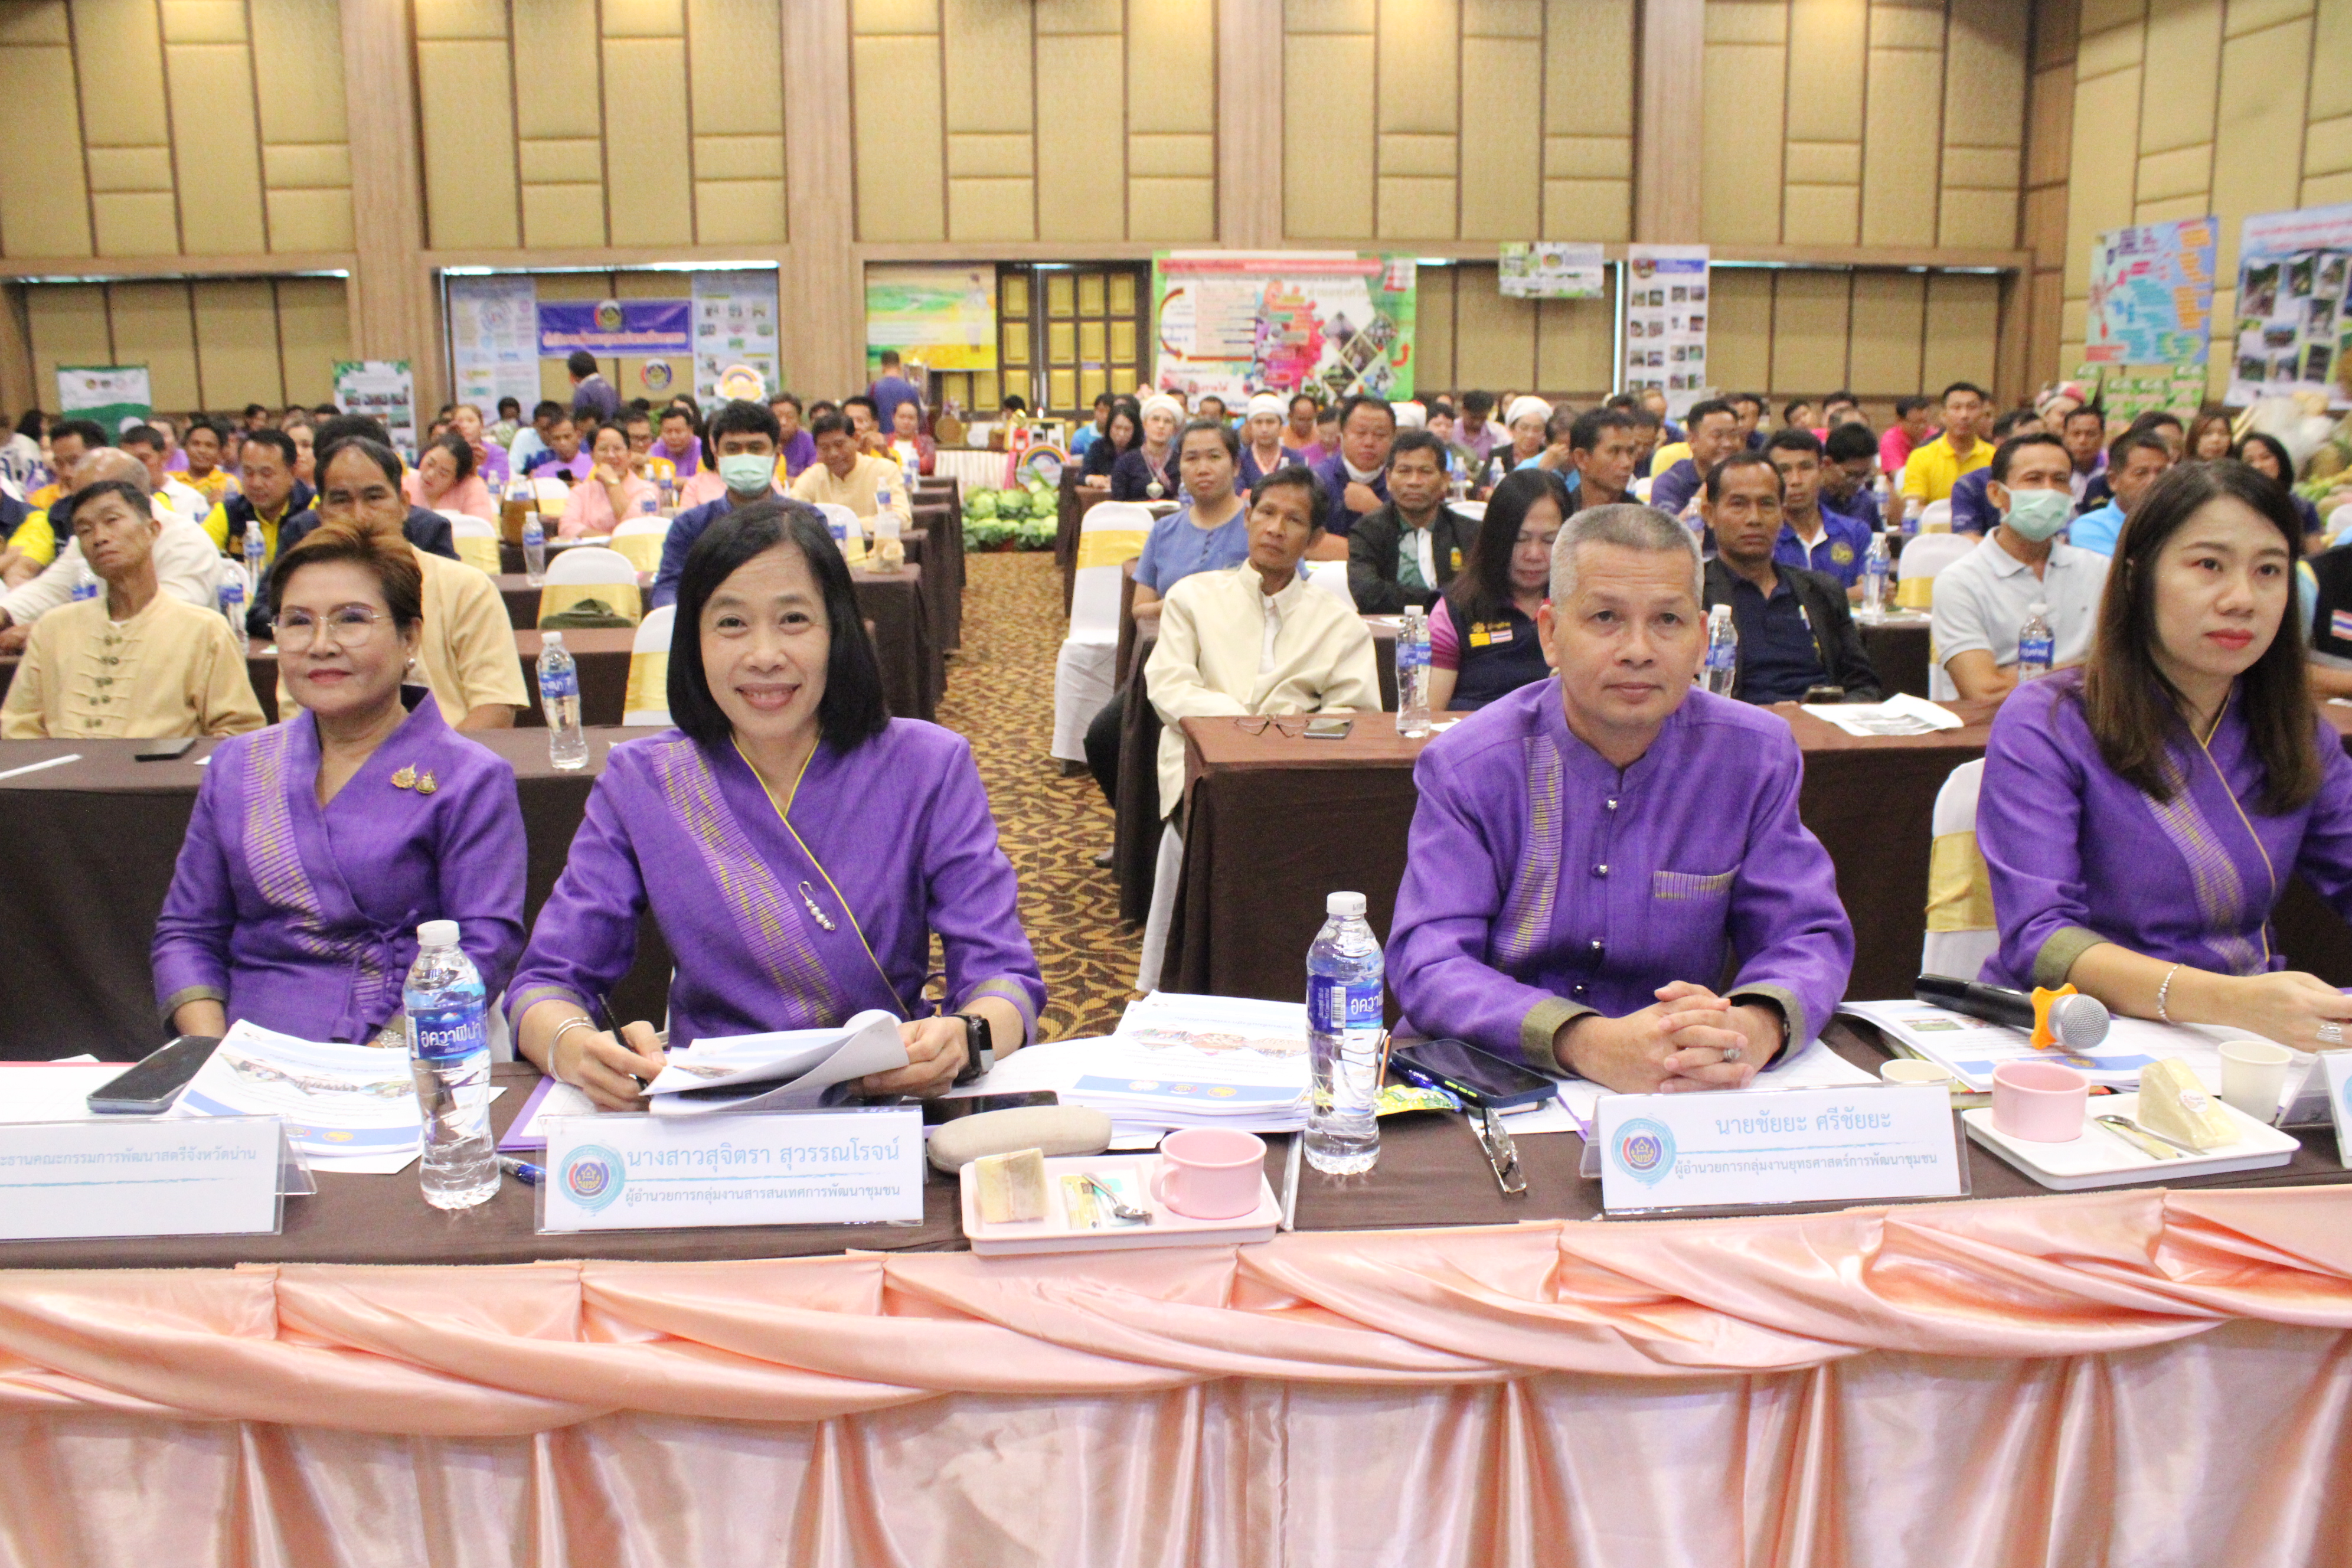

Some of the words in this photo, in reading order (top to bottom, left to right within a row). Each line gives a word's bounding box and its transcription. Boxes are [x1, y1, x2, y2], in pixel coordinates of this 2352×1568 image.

[1715, 1109, 1807, 1135] นายชัยยะ
[1816, 1106, 1892, 1131] ศรีชัยยะ
[627, 1142, 771, 1172] นางสาวสุจิตรา
[780, 1135, 901, 1170] สุวรรณโรจน์
[1675, 1152, 1938, 1180] ผู้อำนวยการกลุ่มงานยุทธศาสตร์การพัฒนาชุมชน
[625, 1183, 901, 1207] ผู้อำนวยการกลุ่มงานสารสนเทศการพัฒนาชุมชน
